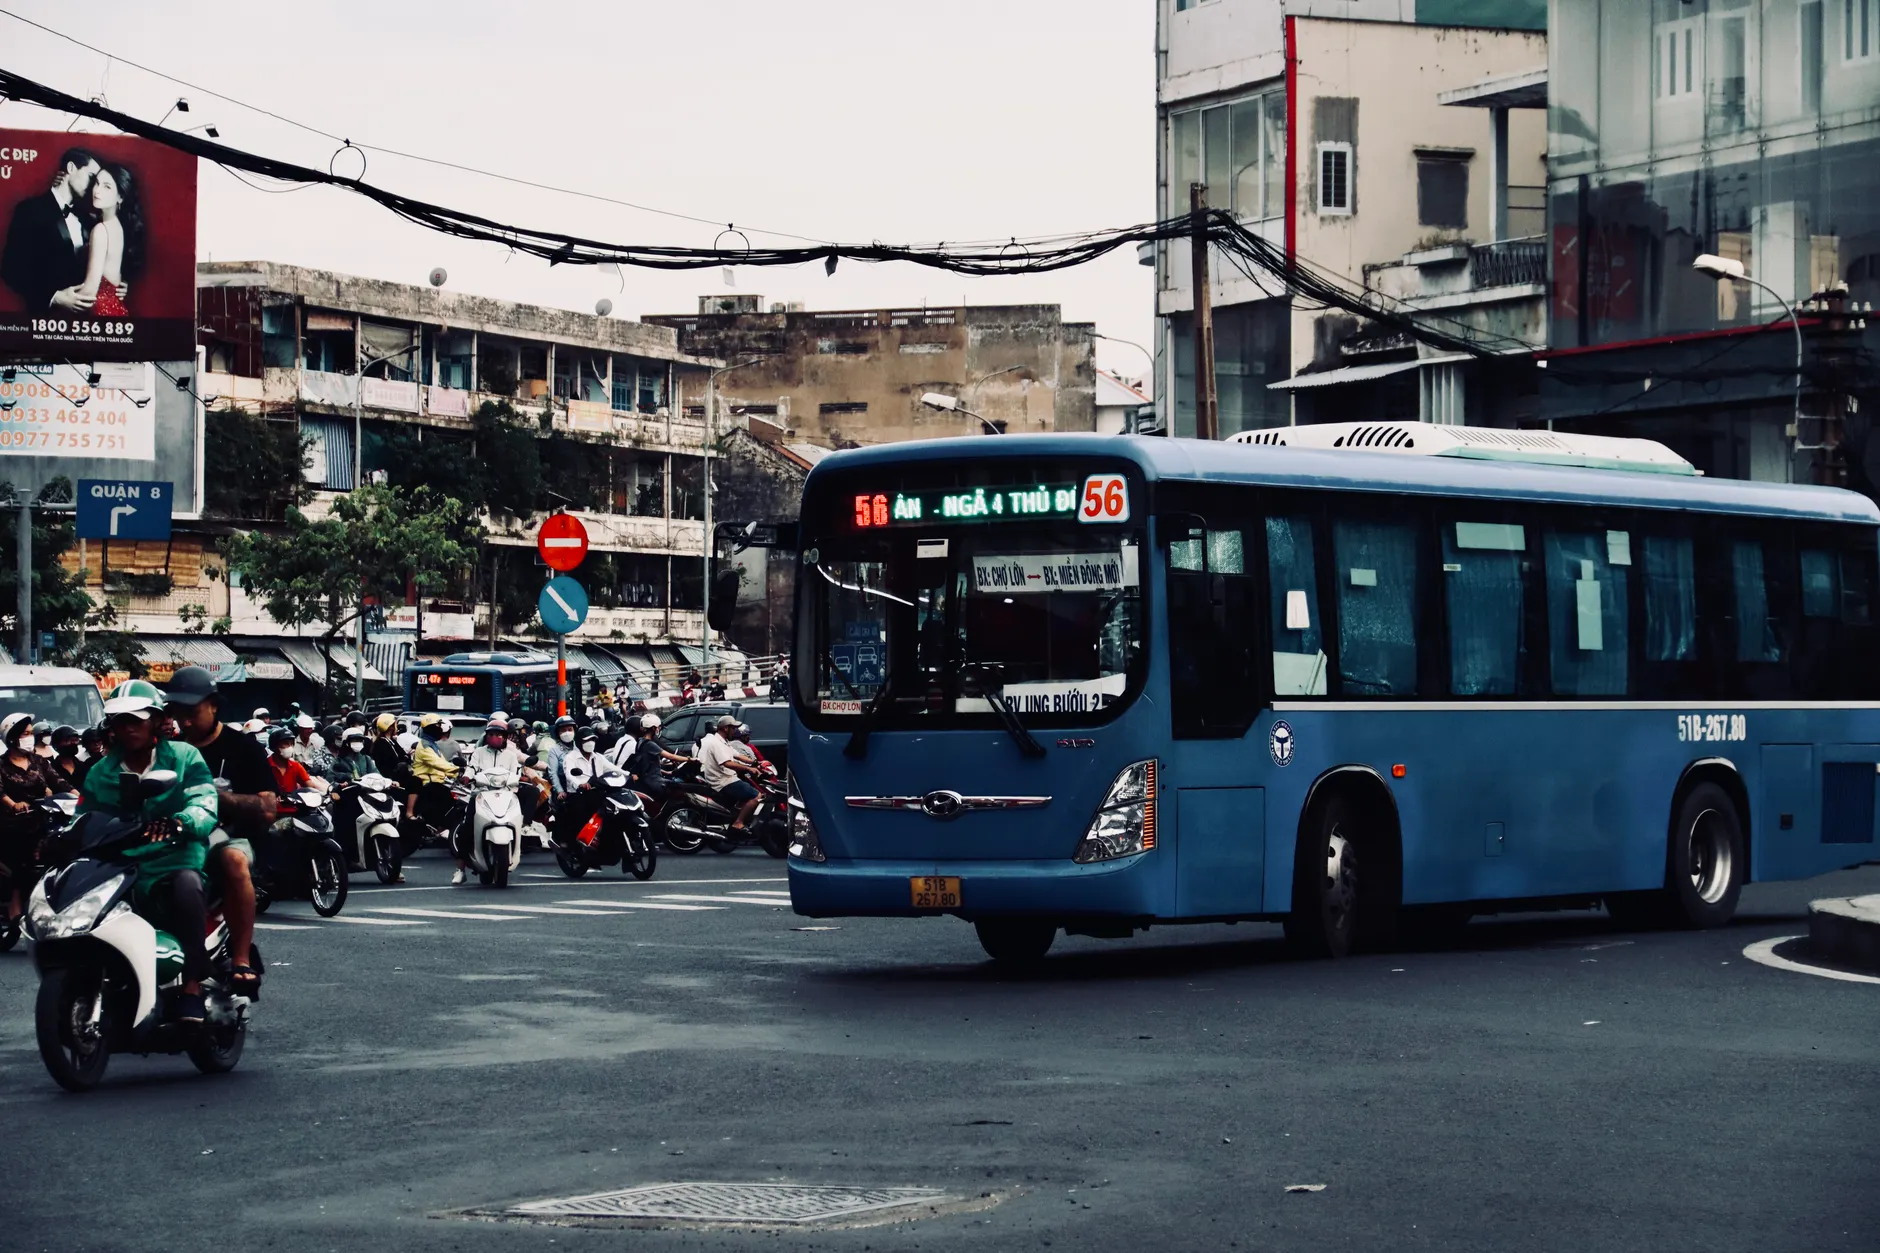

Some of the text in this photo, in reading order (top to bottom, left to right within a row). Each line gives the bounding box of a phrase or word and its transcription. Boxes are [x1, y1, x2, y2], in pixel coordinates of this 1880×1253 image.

[0, 147, 38, 164] C ĐẸP
[31, 319, 134, 335] 1800 556 889
[0, 383, 51, 398] 0908
[55, 384, 91, 400] 328
[0, 407, 127, 426] 0933 462 404
[0, 431, 126, 449] 0977 755 751
[90, 482, 161, 502] QUẬN 8
[942, 488, 989, 518] NGÃ
[991, 492, 1004, 515] 4
[1008, 485, 1050, 514] THỦ
[1083, 479, 1124, 518] 56
[855, 494, 889, 527] 56
[976, 560, 1027, 591] BX: CHỢ LỚN
[1058, 556, 1081, 586] MIỀN
[1080, 559, 1104, 586] ĐÔNG
[1091, 693, 1100, 711] 2
[1678, 714, 1746, 741] 51B-267.80
[924, 878, 947, 891] 51B
